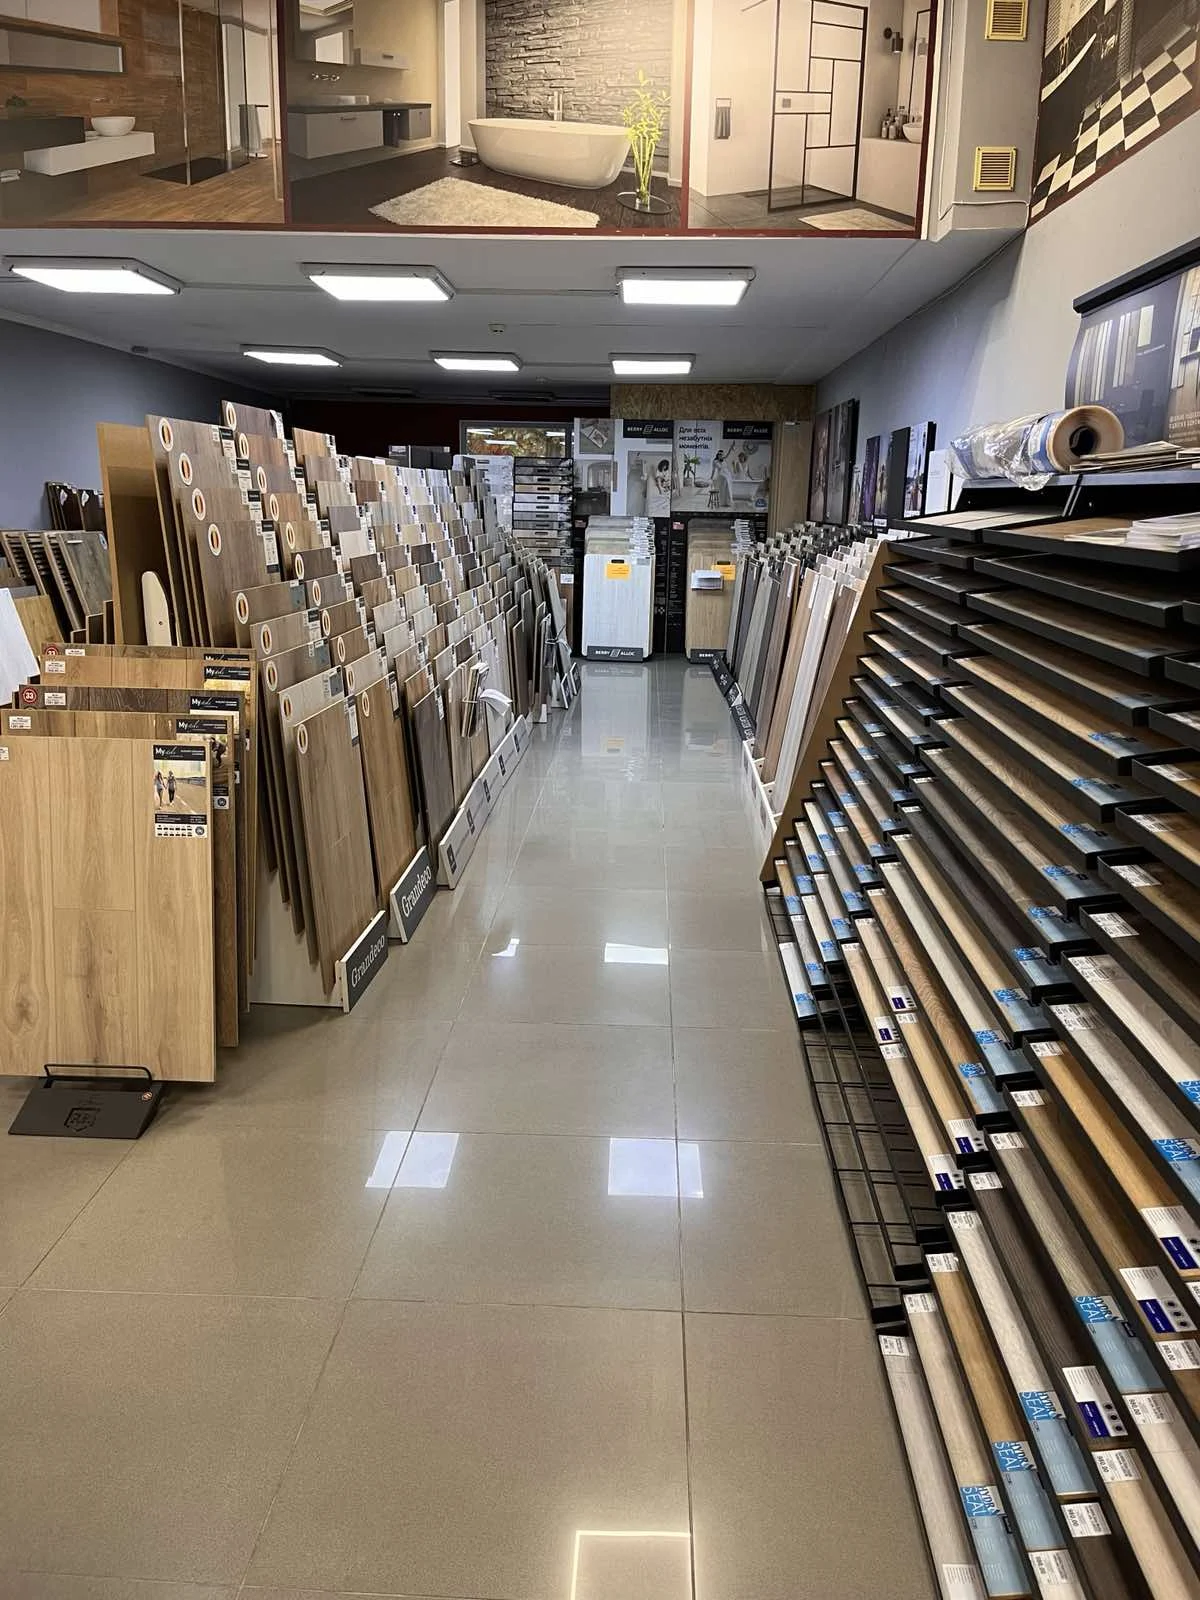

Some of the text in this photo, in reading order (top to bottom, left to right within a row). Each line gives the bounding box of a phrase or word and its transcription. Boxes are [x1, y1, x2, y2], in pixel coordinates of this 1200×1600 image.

[679, 426, 692, 434] Для
[401, 865, 432, 918] Grandeco
[351, 935, 385, 988] Grandeco
[1075, 1296, 1105, 1323] SEAL
[1021, 1391, 1049, 1420] SEAL
[994, 1441, 1023, 1472] SEAL
[962, 1486, 987, 1516] SEAL
